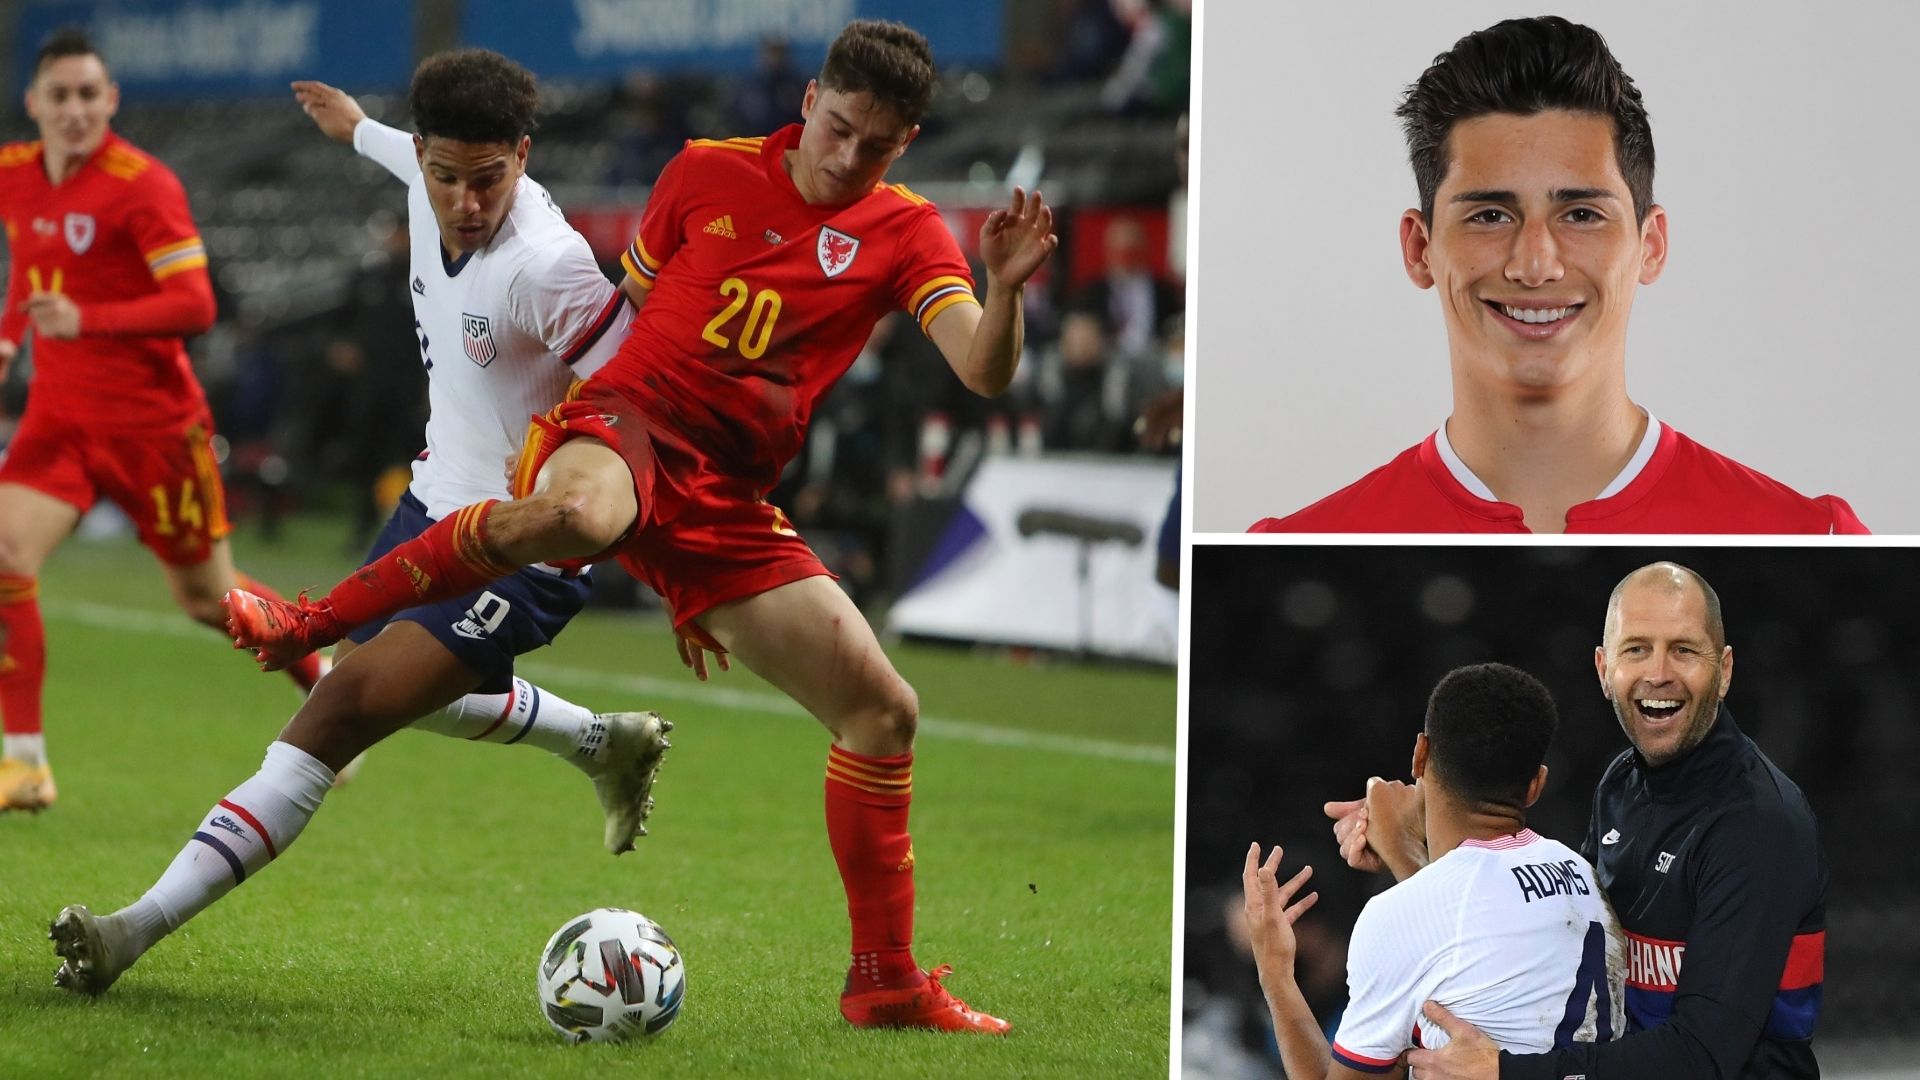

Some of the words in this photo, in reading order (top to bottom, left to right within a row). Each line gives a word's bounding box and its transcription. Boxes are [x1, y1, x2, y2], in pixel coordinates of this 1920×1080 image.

[703, 224, 737, 240] adidas
[464, 317, 487, 338] USA
[702, 277, 782, 360] 20
[151, 478, 203, 535] 14
[457, 617, 485, 637] NIKE
[517, 679, 529, 713] USA
[1511, 859, 1590, 903] ADAMS
[1554, 921, 1615, 1050] 4
